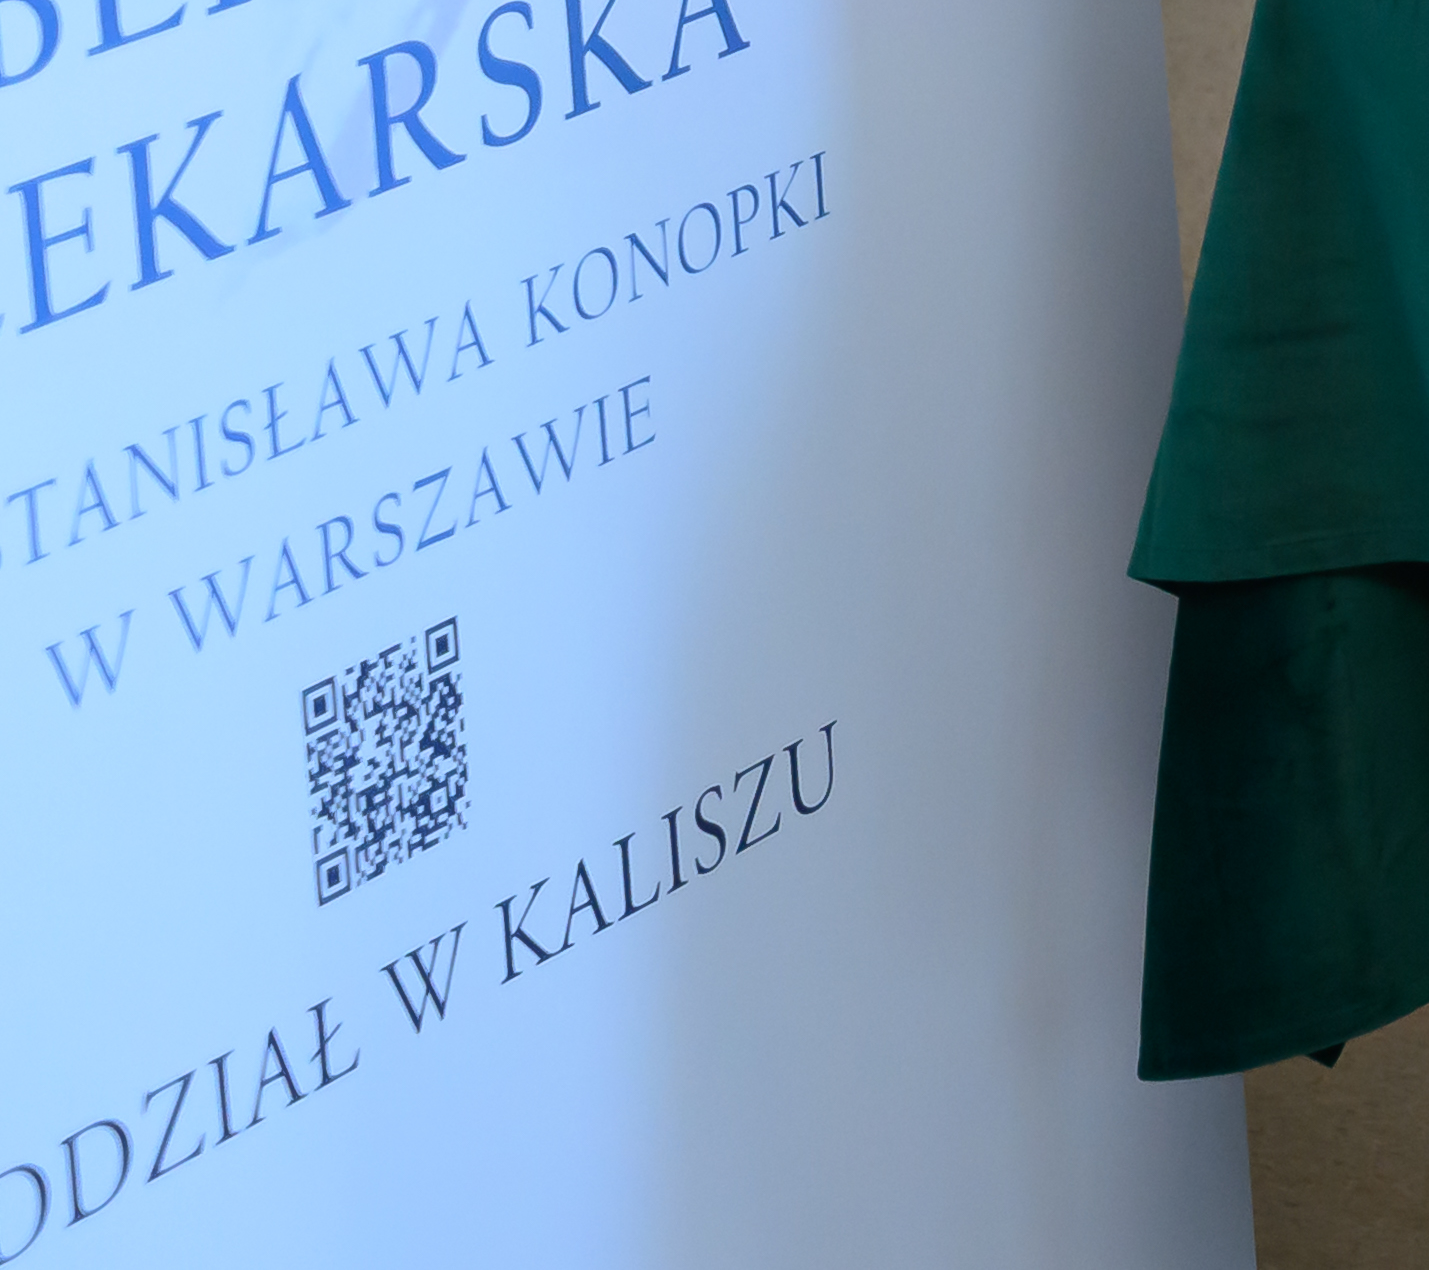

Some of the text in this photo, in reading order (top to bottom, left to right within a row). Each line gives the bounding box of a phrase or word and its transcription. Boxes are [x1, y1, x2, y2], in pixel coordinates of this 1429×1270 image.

[0, 151, 831, 566] TANISŁAWA KONOPKI
[45, 376, 657, 711] W WARSZAWIE
[381, 923, 468, 1036] W
[501, 721, 839, 986] KALISZU
